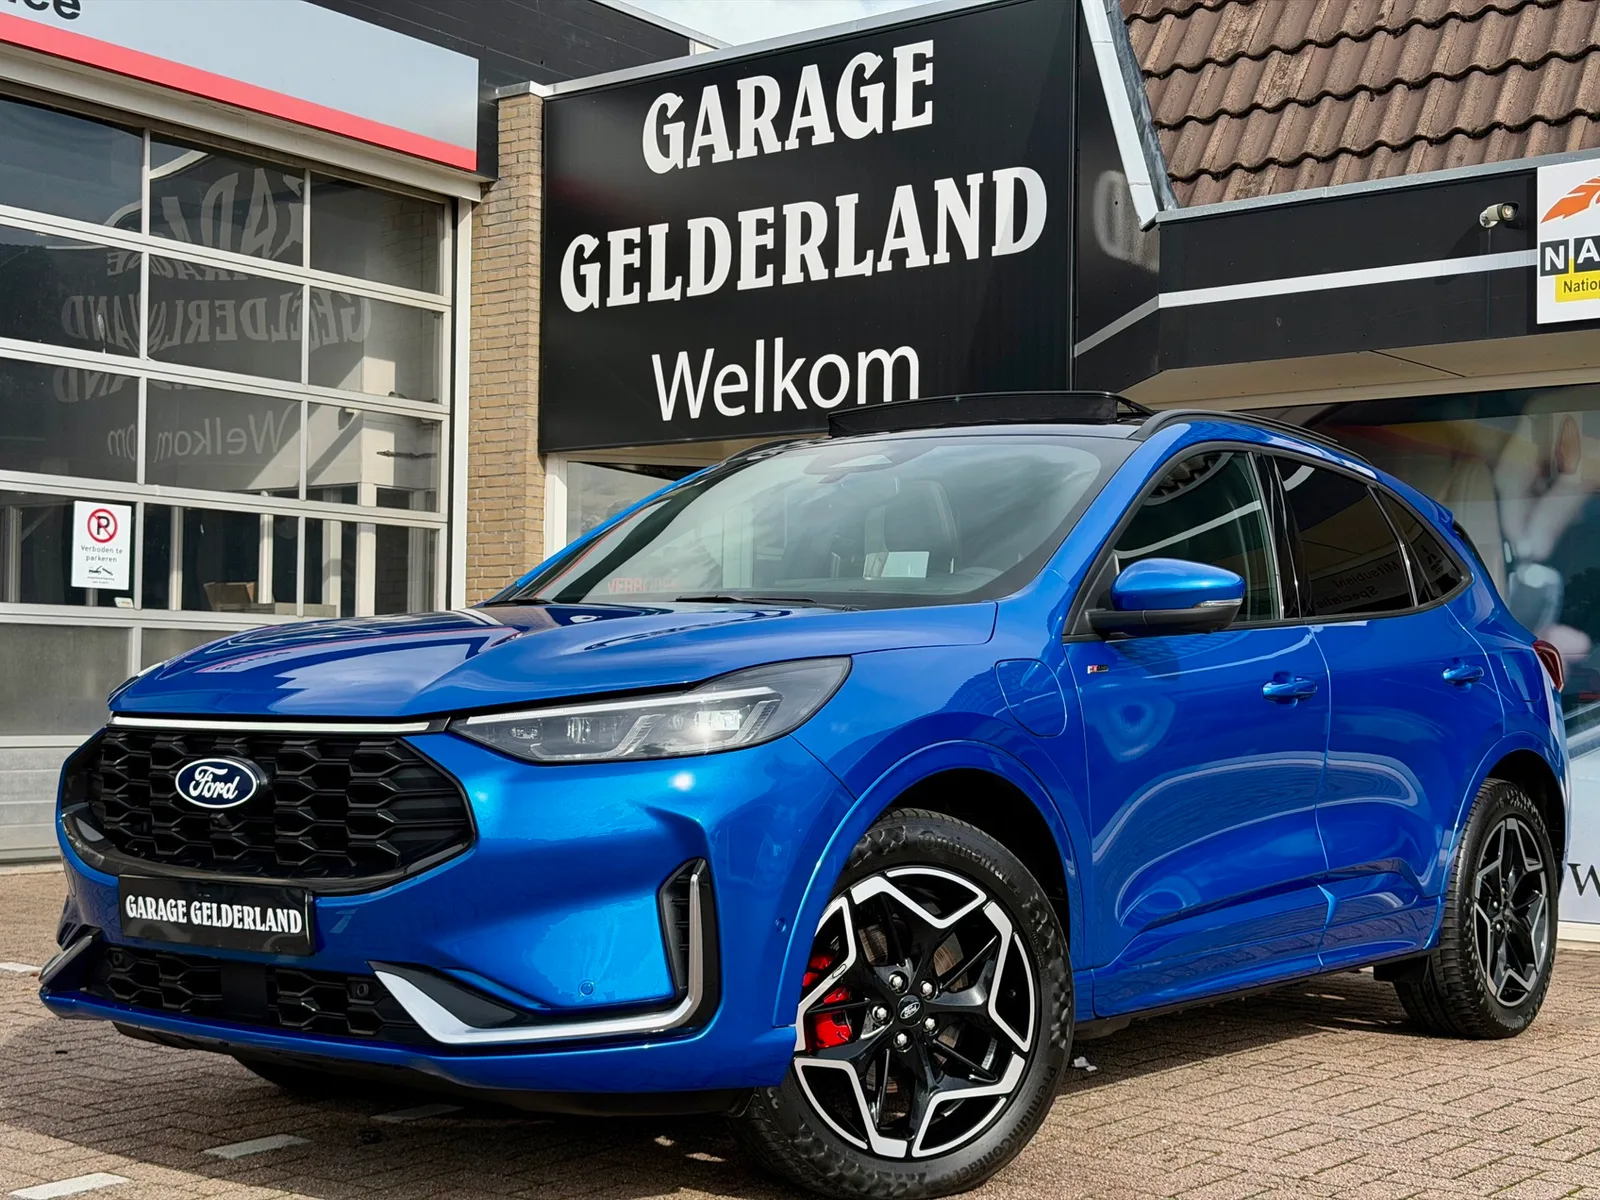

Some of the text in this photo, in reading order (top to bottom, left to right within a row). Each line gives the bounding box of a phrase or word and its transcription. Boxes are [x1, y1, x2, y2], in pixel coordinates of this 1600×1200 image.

[642, 39, 934, 174] GARAGE
[559, 166, 1048, 313] GELDERLAND
[1563, 278, 1600, 294] Natio
[651, 337, 920, 422] Welkom
[80, 544, 114, 554] Verboden
[85, 555, 118, 563] parkeren
[188, 765, 241, 800] Ford
[125, 894, 303, 934] GARAGE GELDERLAND
